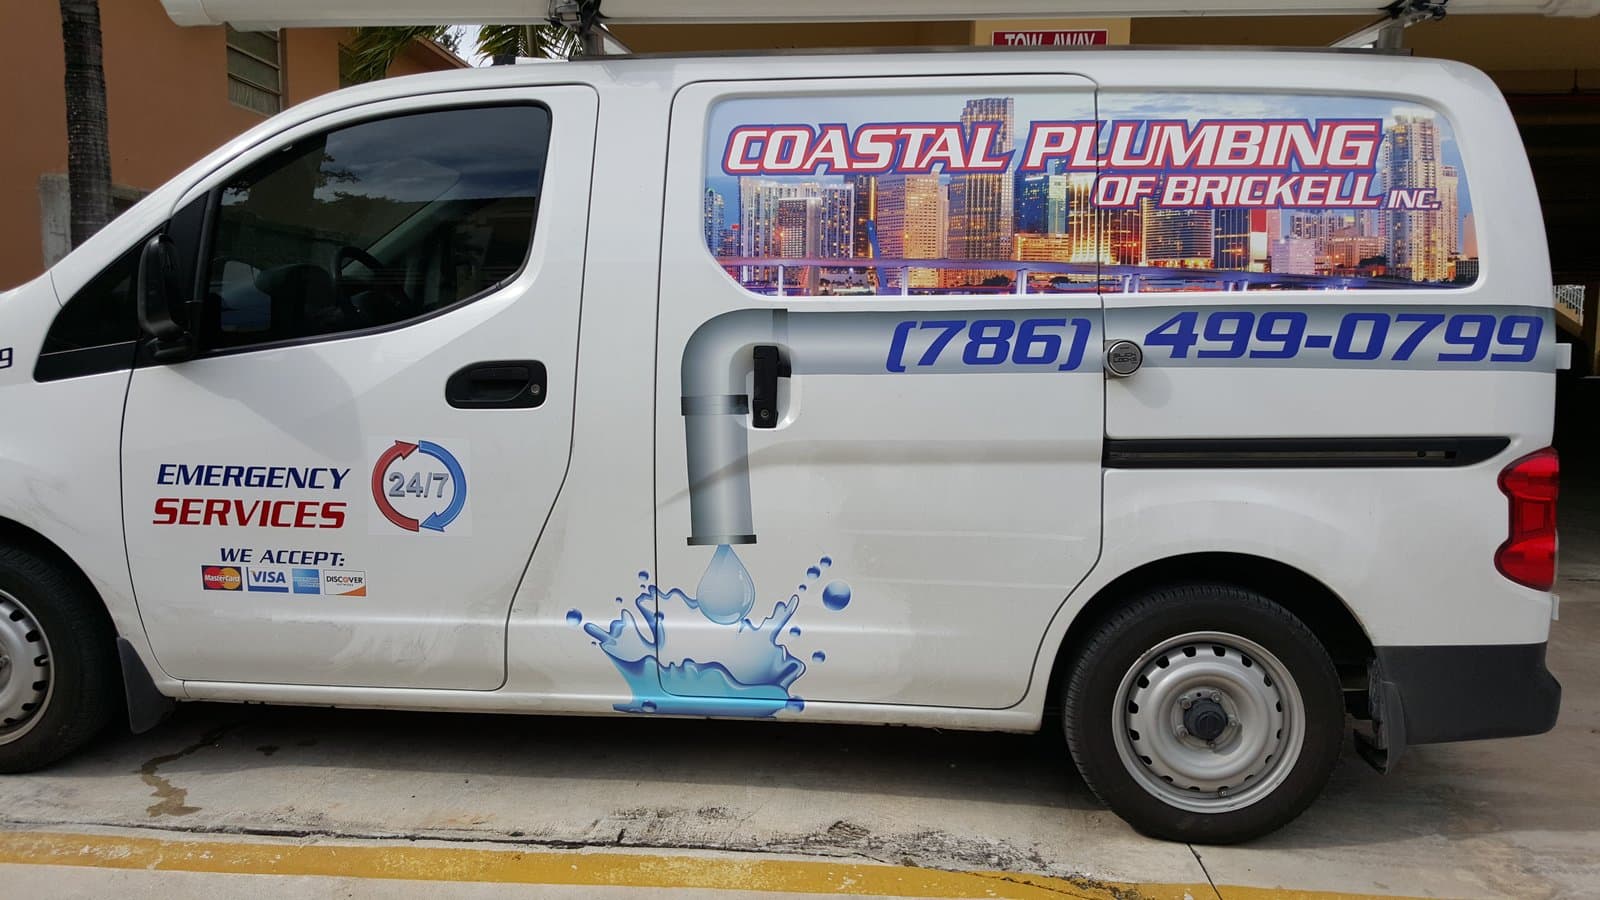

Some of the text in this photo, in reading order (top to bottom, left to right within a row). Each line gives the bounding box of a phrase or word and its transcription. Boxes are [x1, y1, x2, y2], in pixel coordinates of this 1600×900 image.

[722, 119, 1383, 174] COASTAL PLUMBING
[1092, 172, 1441, 210] OF BRICKELL INC.
[886, 311, 1544, 372] (786) 499-0799
[157, 463, 351, 490] EMERGENCY
[388, 471, 449, 498] 24/7
[152, 497, 347, 529] SERVICES
[220, 547, 345, 567] WE ACCEPT:
[204, 573, 241, 583] MasterCard
[252, 570, 287, 584] VISA
[326, 575, 363, 585] DISCOVER
